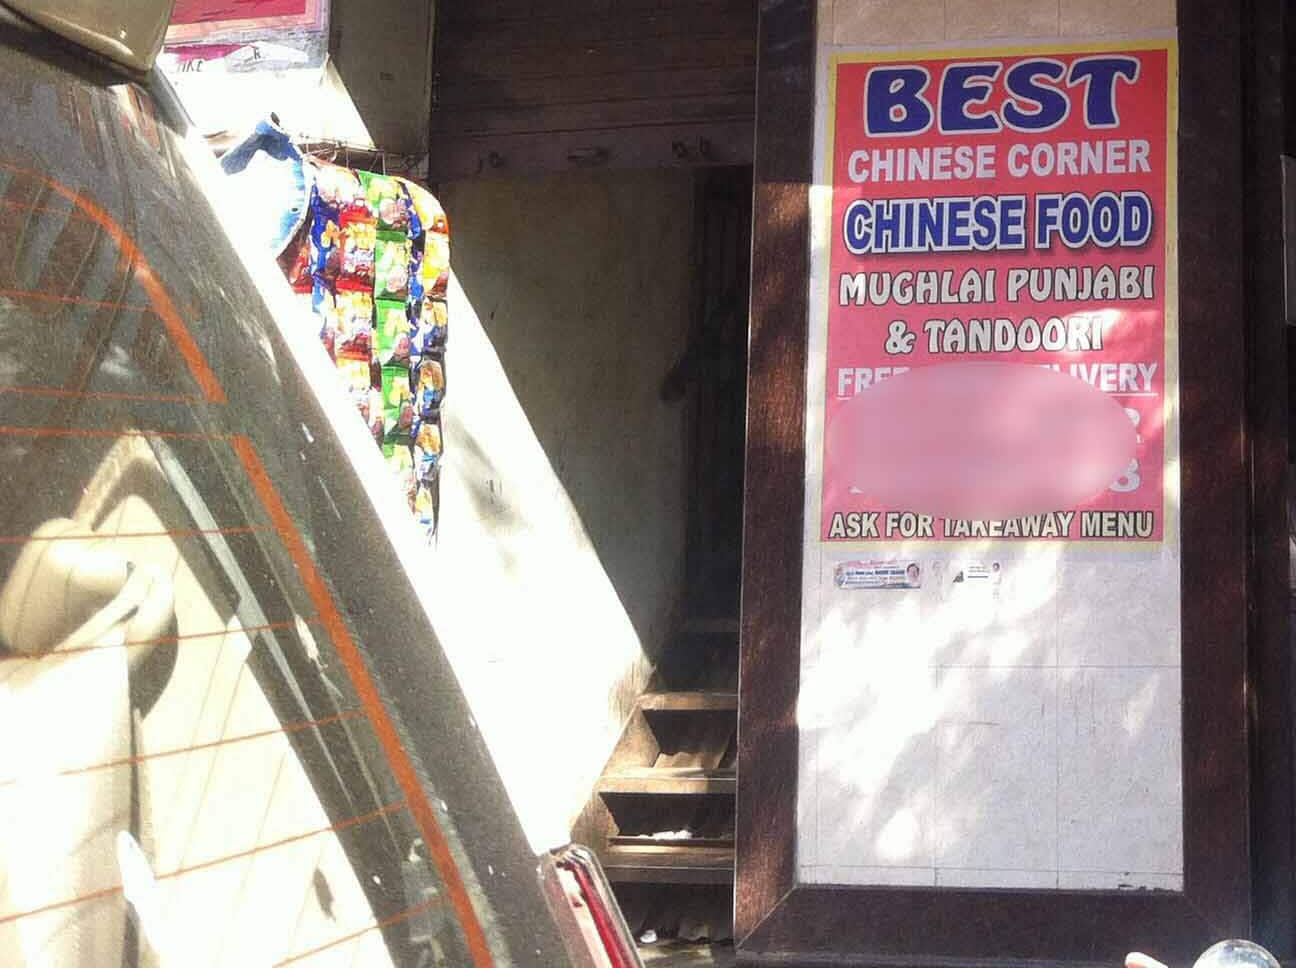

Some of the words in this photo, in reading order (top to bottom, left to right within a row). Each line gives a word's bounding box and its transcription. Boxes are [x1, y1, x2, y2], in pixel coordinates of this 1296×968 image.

[866, 57, 1140, 136] BEST
[847, 144, 996, 183] CHINESE
[1007, 140, 1152, 178] CORNER
[843, 195, 1027, 255] CHINESE
[1034, 191, 1154, 248] FOOD
[838, 268, 996, 305] MUGHLAI
[1007, 265, 1156, 302] PUNJABI
[885, 320, 916, 354] &
[924, 317, 1104, 353] TANDOORI
[828, 512, 881, 538] ASK
[885, 512, 935, 537] FOR
[1080, 510, 1154, 537] MENU
